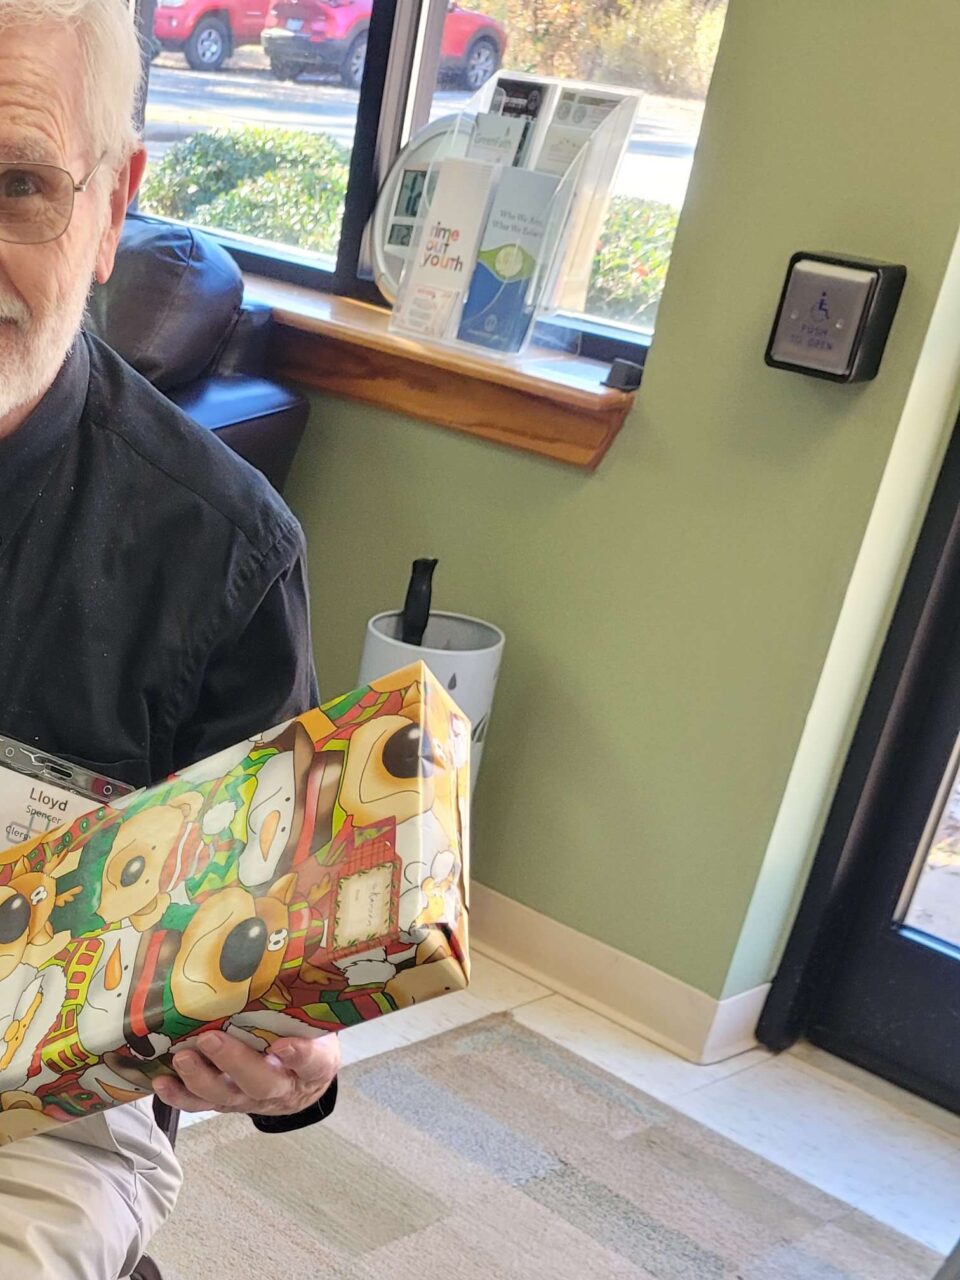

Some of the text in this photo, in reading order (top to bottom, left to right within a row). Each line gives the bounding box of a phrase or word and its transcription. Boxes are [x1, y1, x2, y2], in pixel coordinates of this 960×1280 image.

[421, 252, 462, 272] youth
[29, 787, 68, 812] Lloyd
[26, 805, 62, 825] Spencer
